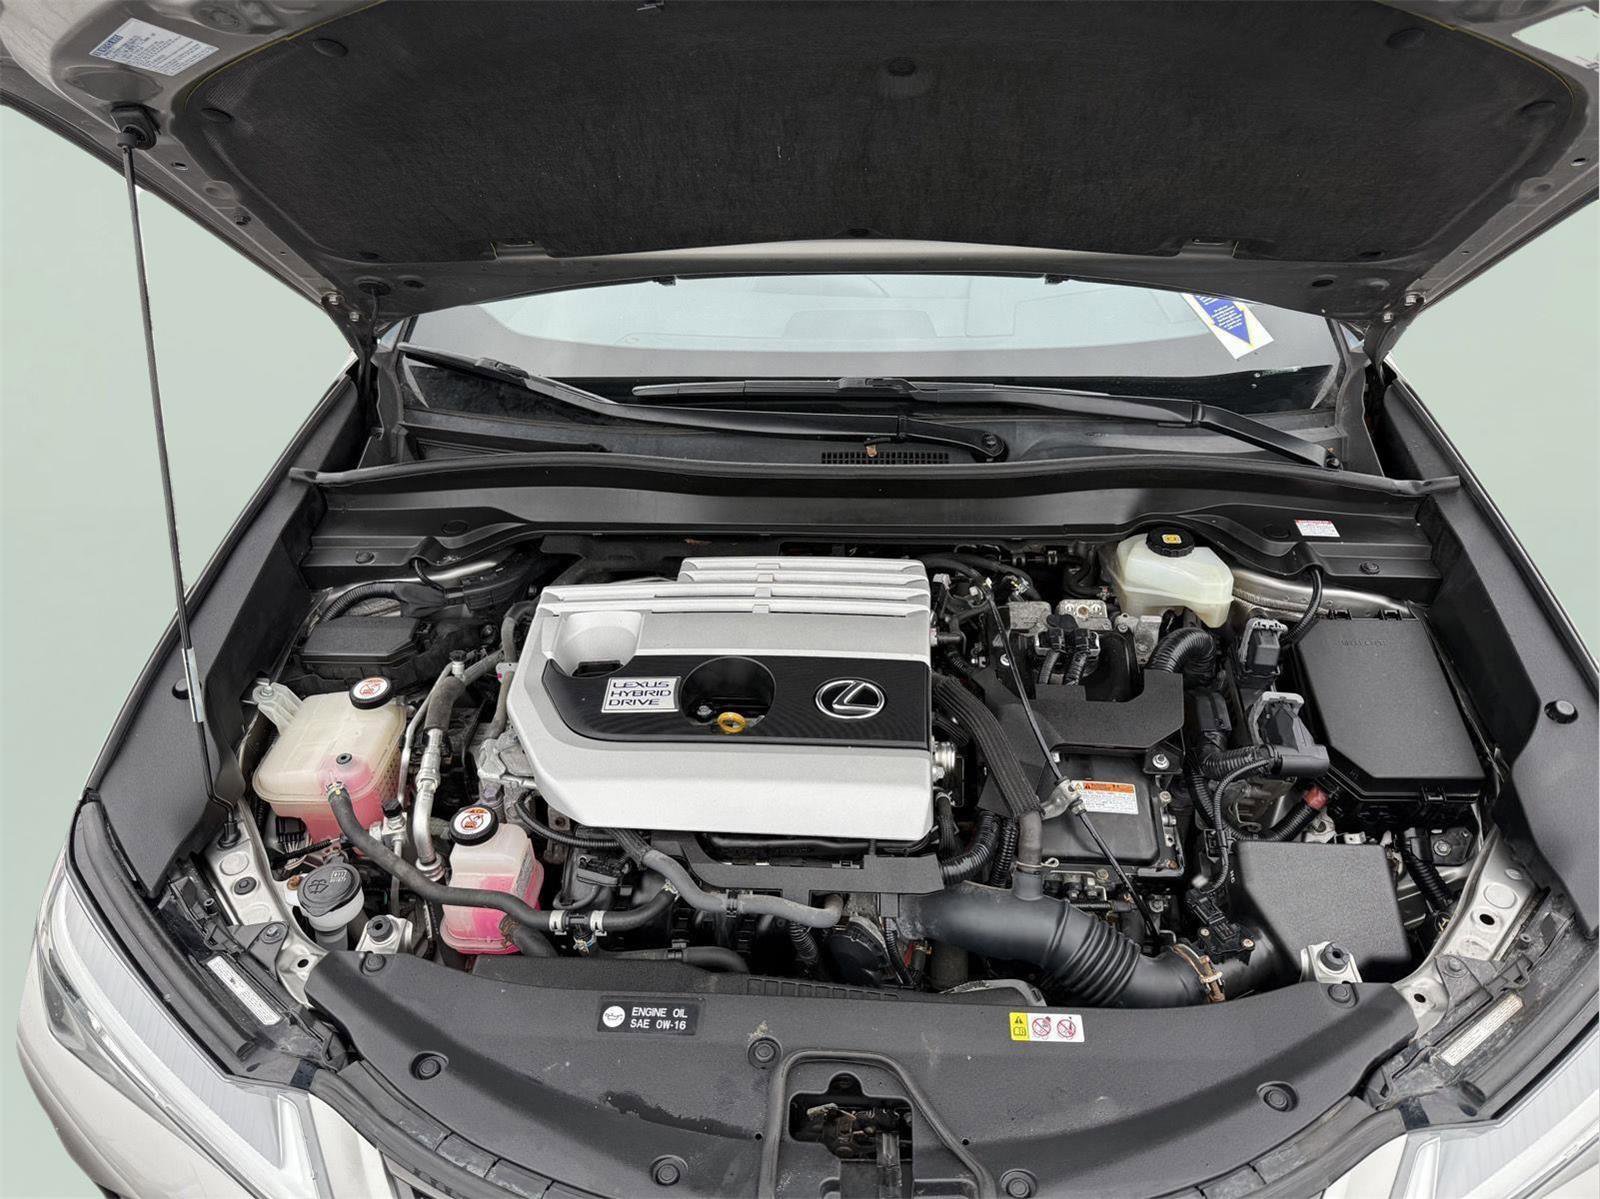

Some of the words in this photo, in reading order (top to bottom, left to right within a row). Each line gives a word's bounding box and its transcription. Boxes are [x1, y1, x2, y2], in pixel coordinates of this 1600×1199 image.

[610, 689, 671, 697] HYBRID
[608, 698, 660, 706] DRIVE
[631, 1006, 668, 1017] ENGINE
[672, 1008, 688, 1018] OIL
[630, 1018, 650, 1029] SAE
[655, 1019, 687, 1030] 0W-16
